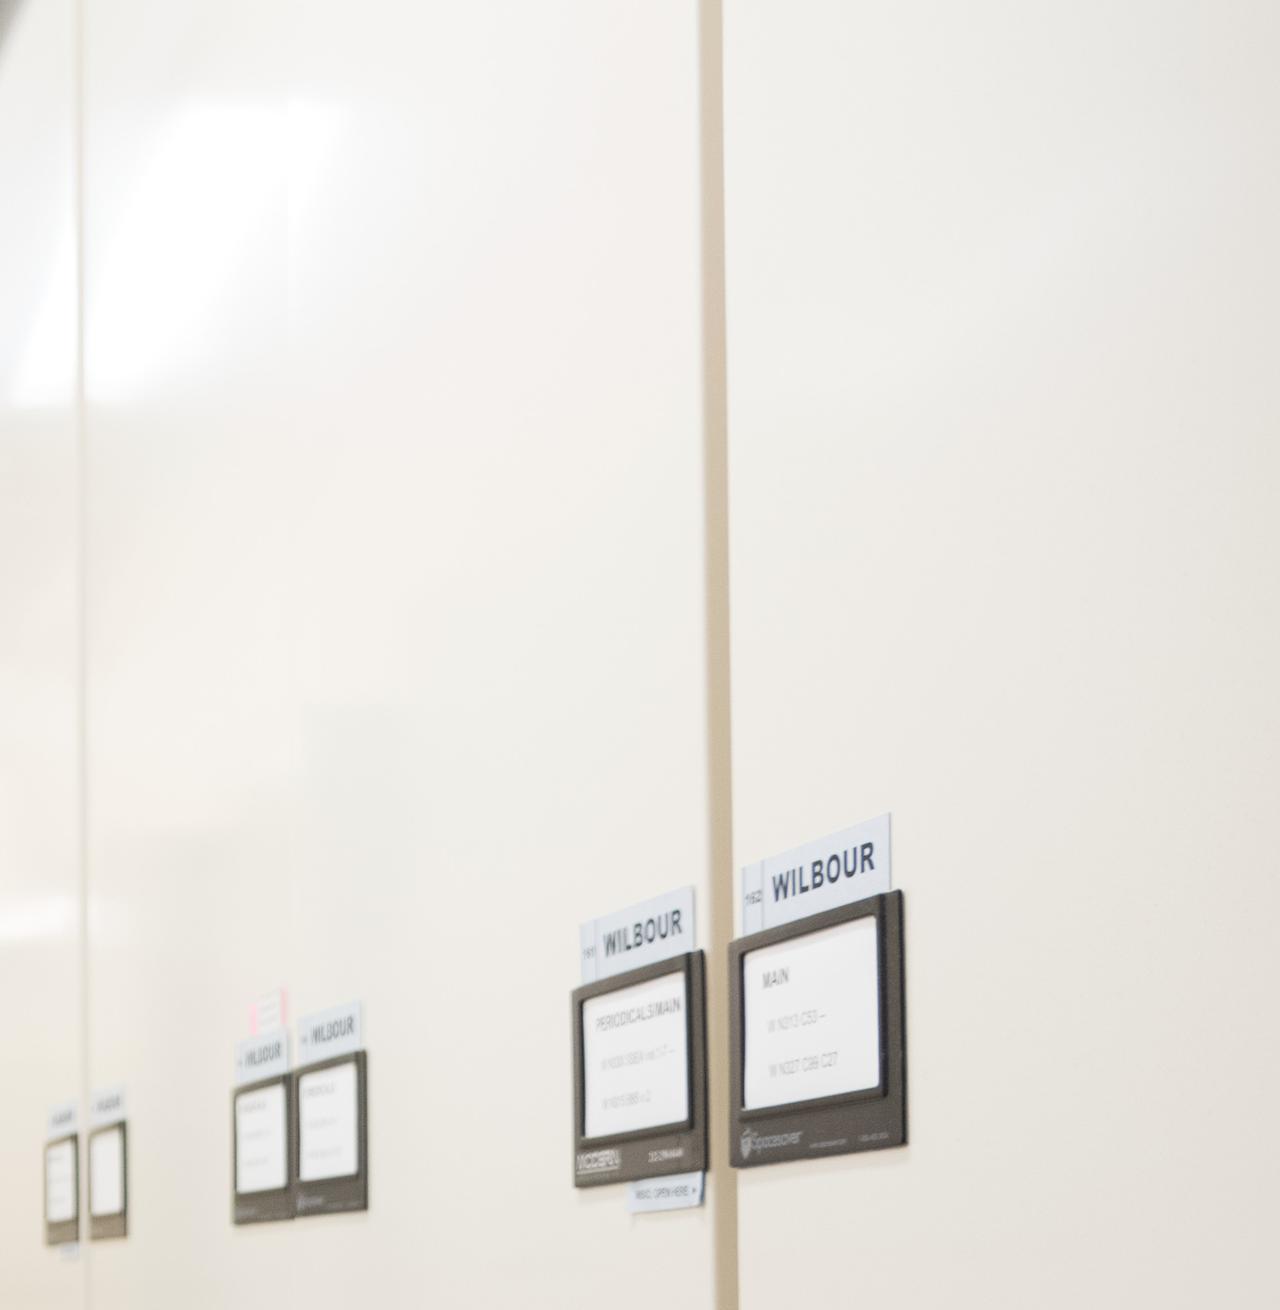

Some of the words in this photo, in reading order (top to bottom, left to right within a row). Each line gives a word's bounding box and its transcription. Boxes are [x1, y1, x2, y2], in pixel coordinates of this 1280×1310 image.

[772, 841, 876, 904] WILBOUR
[603, 909, 683, 958] WILBOUR
[761, 966, 791, 990] MAIN
[311, 1015, 356, 1046] WILBOUR
[244, 1038, 282, 1068] WILBOUR
